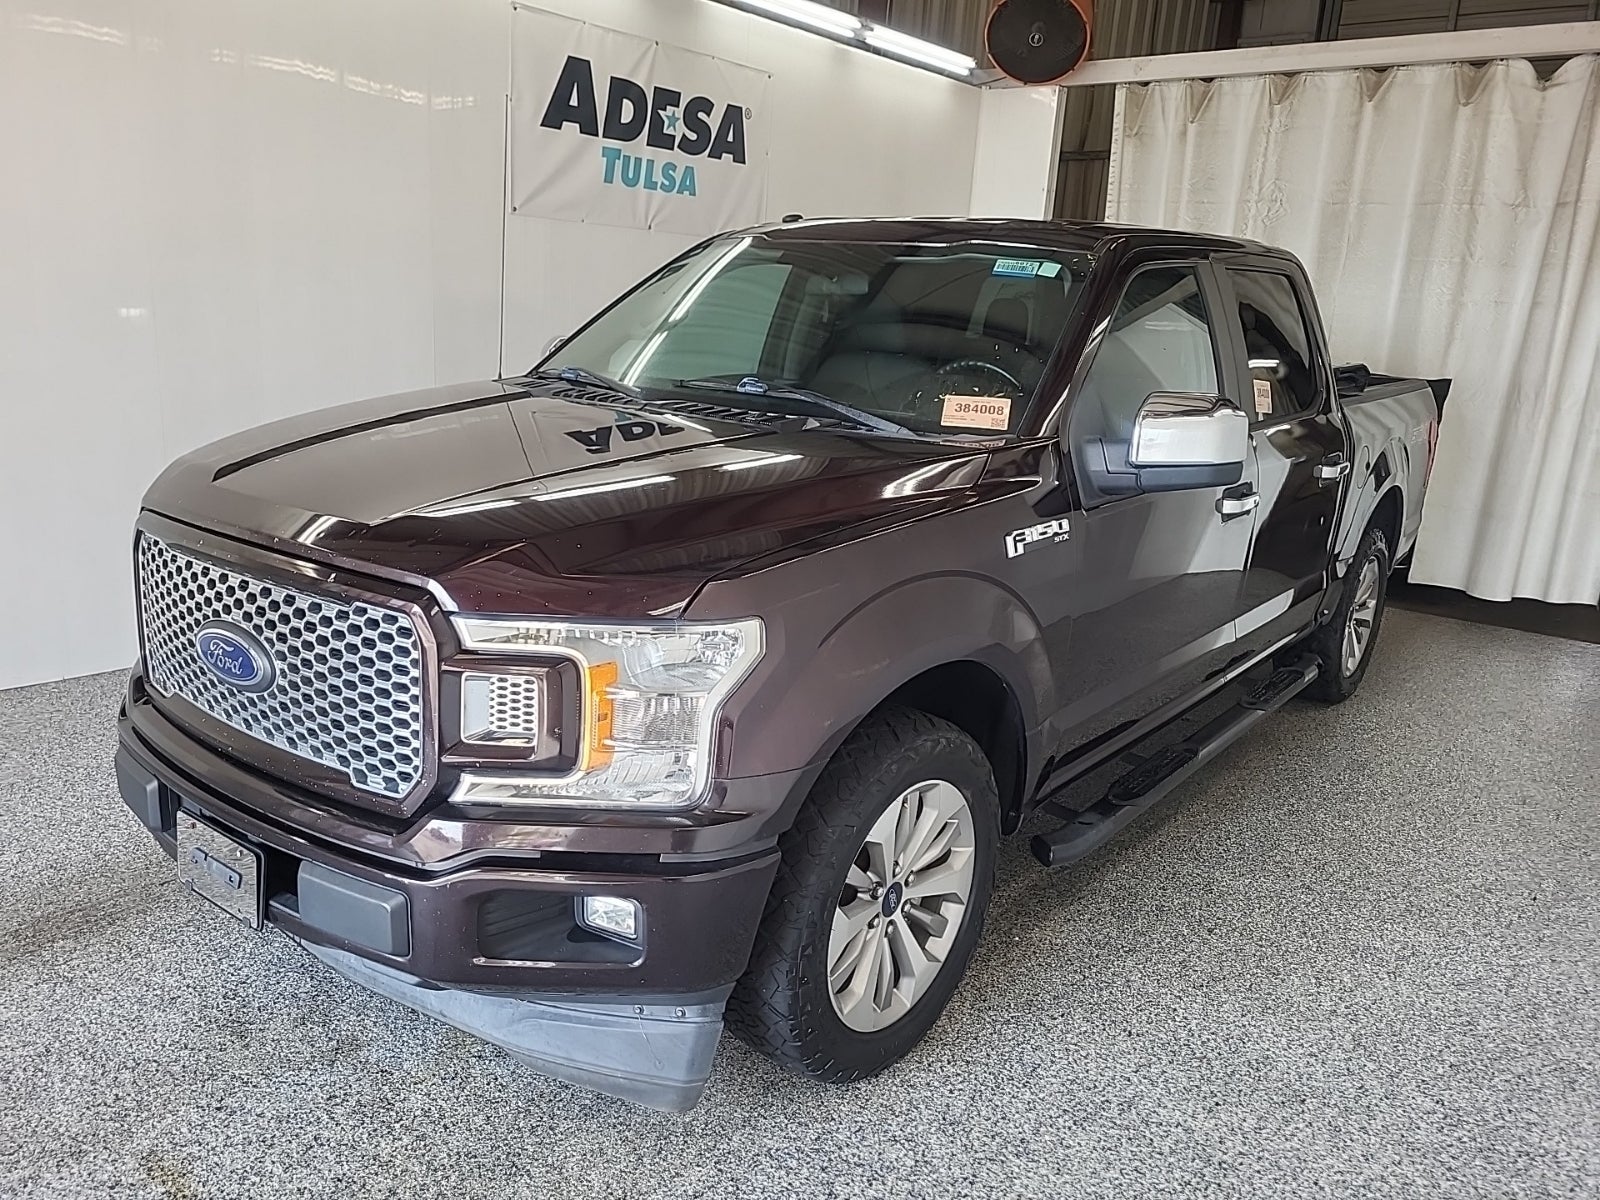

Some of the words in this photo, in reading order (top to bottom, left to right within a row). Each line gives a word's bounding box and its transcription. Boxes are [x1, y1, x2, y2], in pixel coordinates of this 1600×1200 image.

[540, 55, 746, 165] ADESA
[602, 147, 697, 196] TULSA
[954, 403, 1004, 415] 384008
[1053, 533, 1070, 543] STX
[208, 639, 243, 674] Ford
